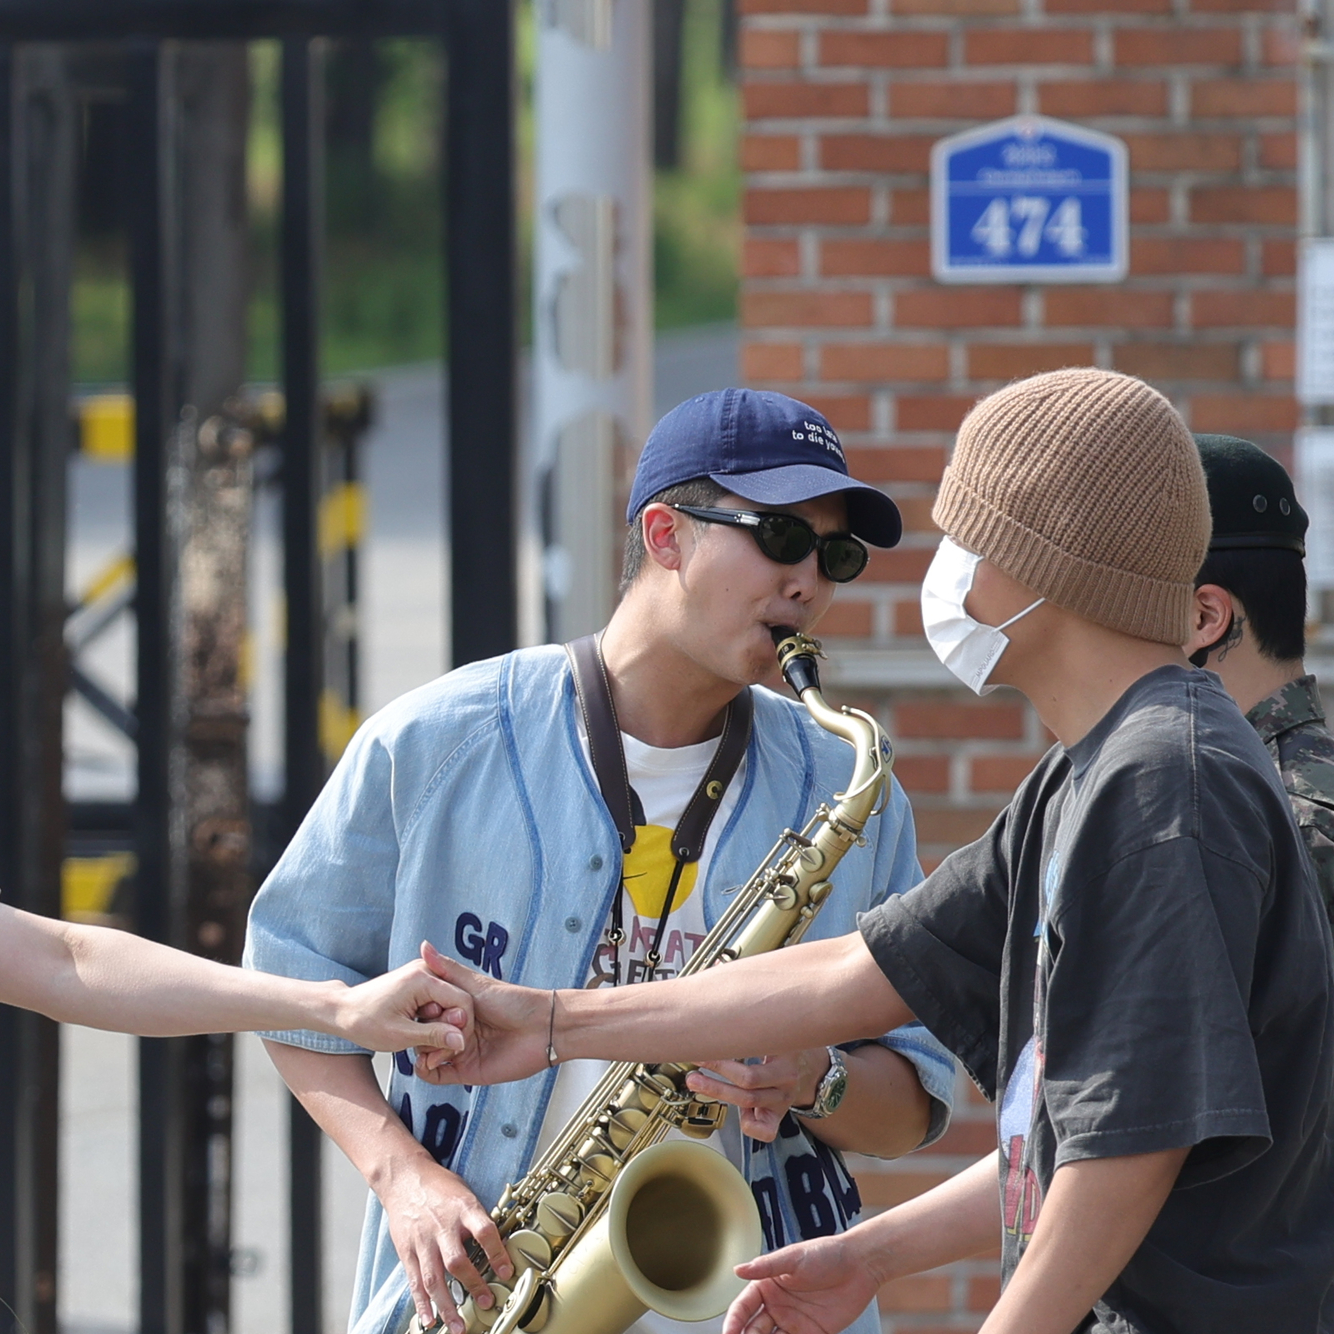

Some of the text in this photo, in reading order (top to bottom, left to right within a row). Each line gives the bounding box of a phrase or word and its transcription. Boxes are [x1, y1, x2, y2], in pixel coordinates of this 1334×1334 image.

[971, 195, 1089, 257] 474
[804, 421, 822, 433] too
[792, 430, 804, 440] to
[808, 432, 824, 445] die
